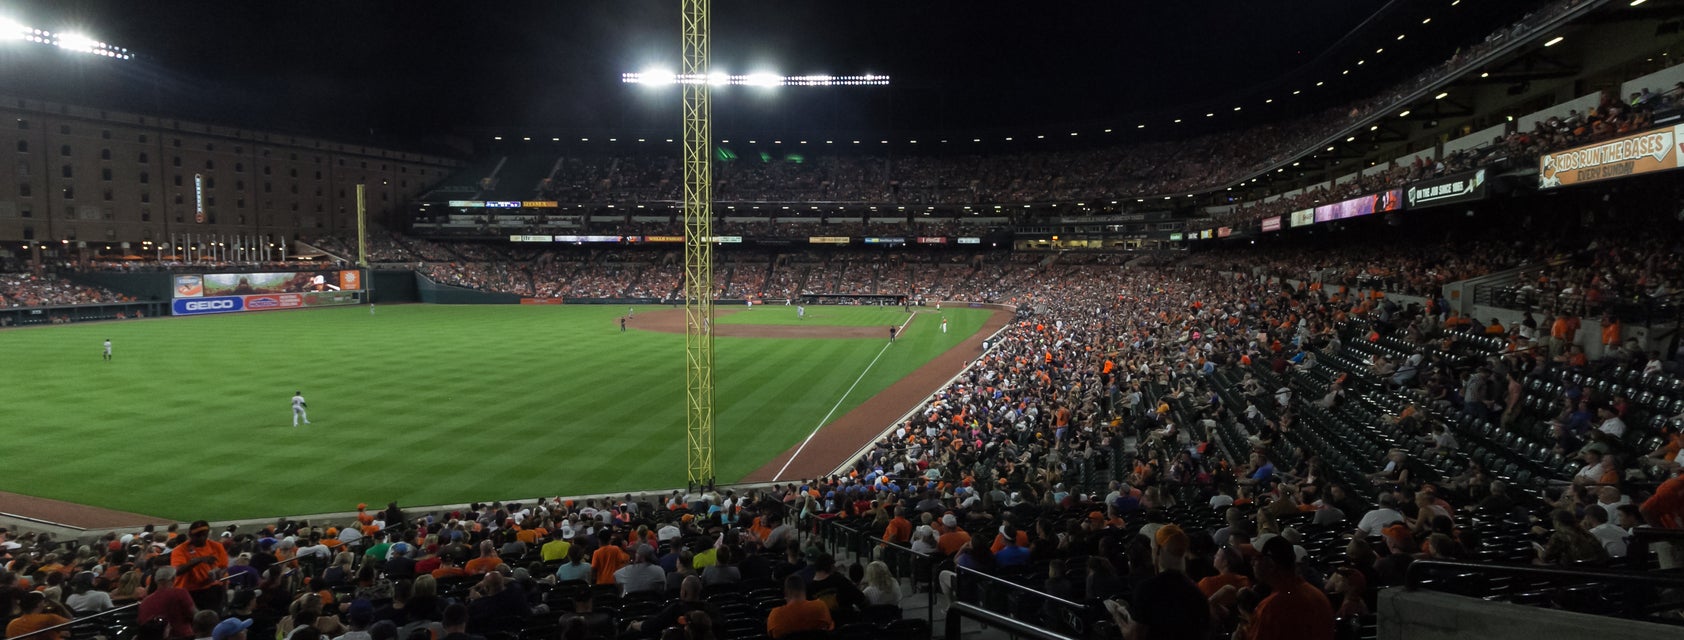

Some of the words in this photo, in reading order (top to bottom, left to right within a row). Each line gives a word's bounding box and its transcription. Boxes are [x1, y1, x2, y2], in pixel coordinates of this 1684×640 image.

[1556, 153, 1579, 172] KIDS
[1579, 148, 1601, 168] RUN
[1602, 142, 1623, 163] THE
[1623, 134, 1663, 158] BASES
[1577, 166, 1600, 181] EVERY
[1601, 161, 1635, 178] SUNDAY
[185, 299, 233, 311] GEICO
